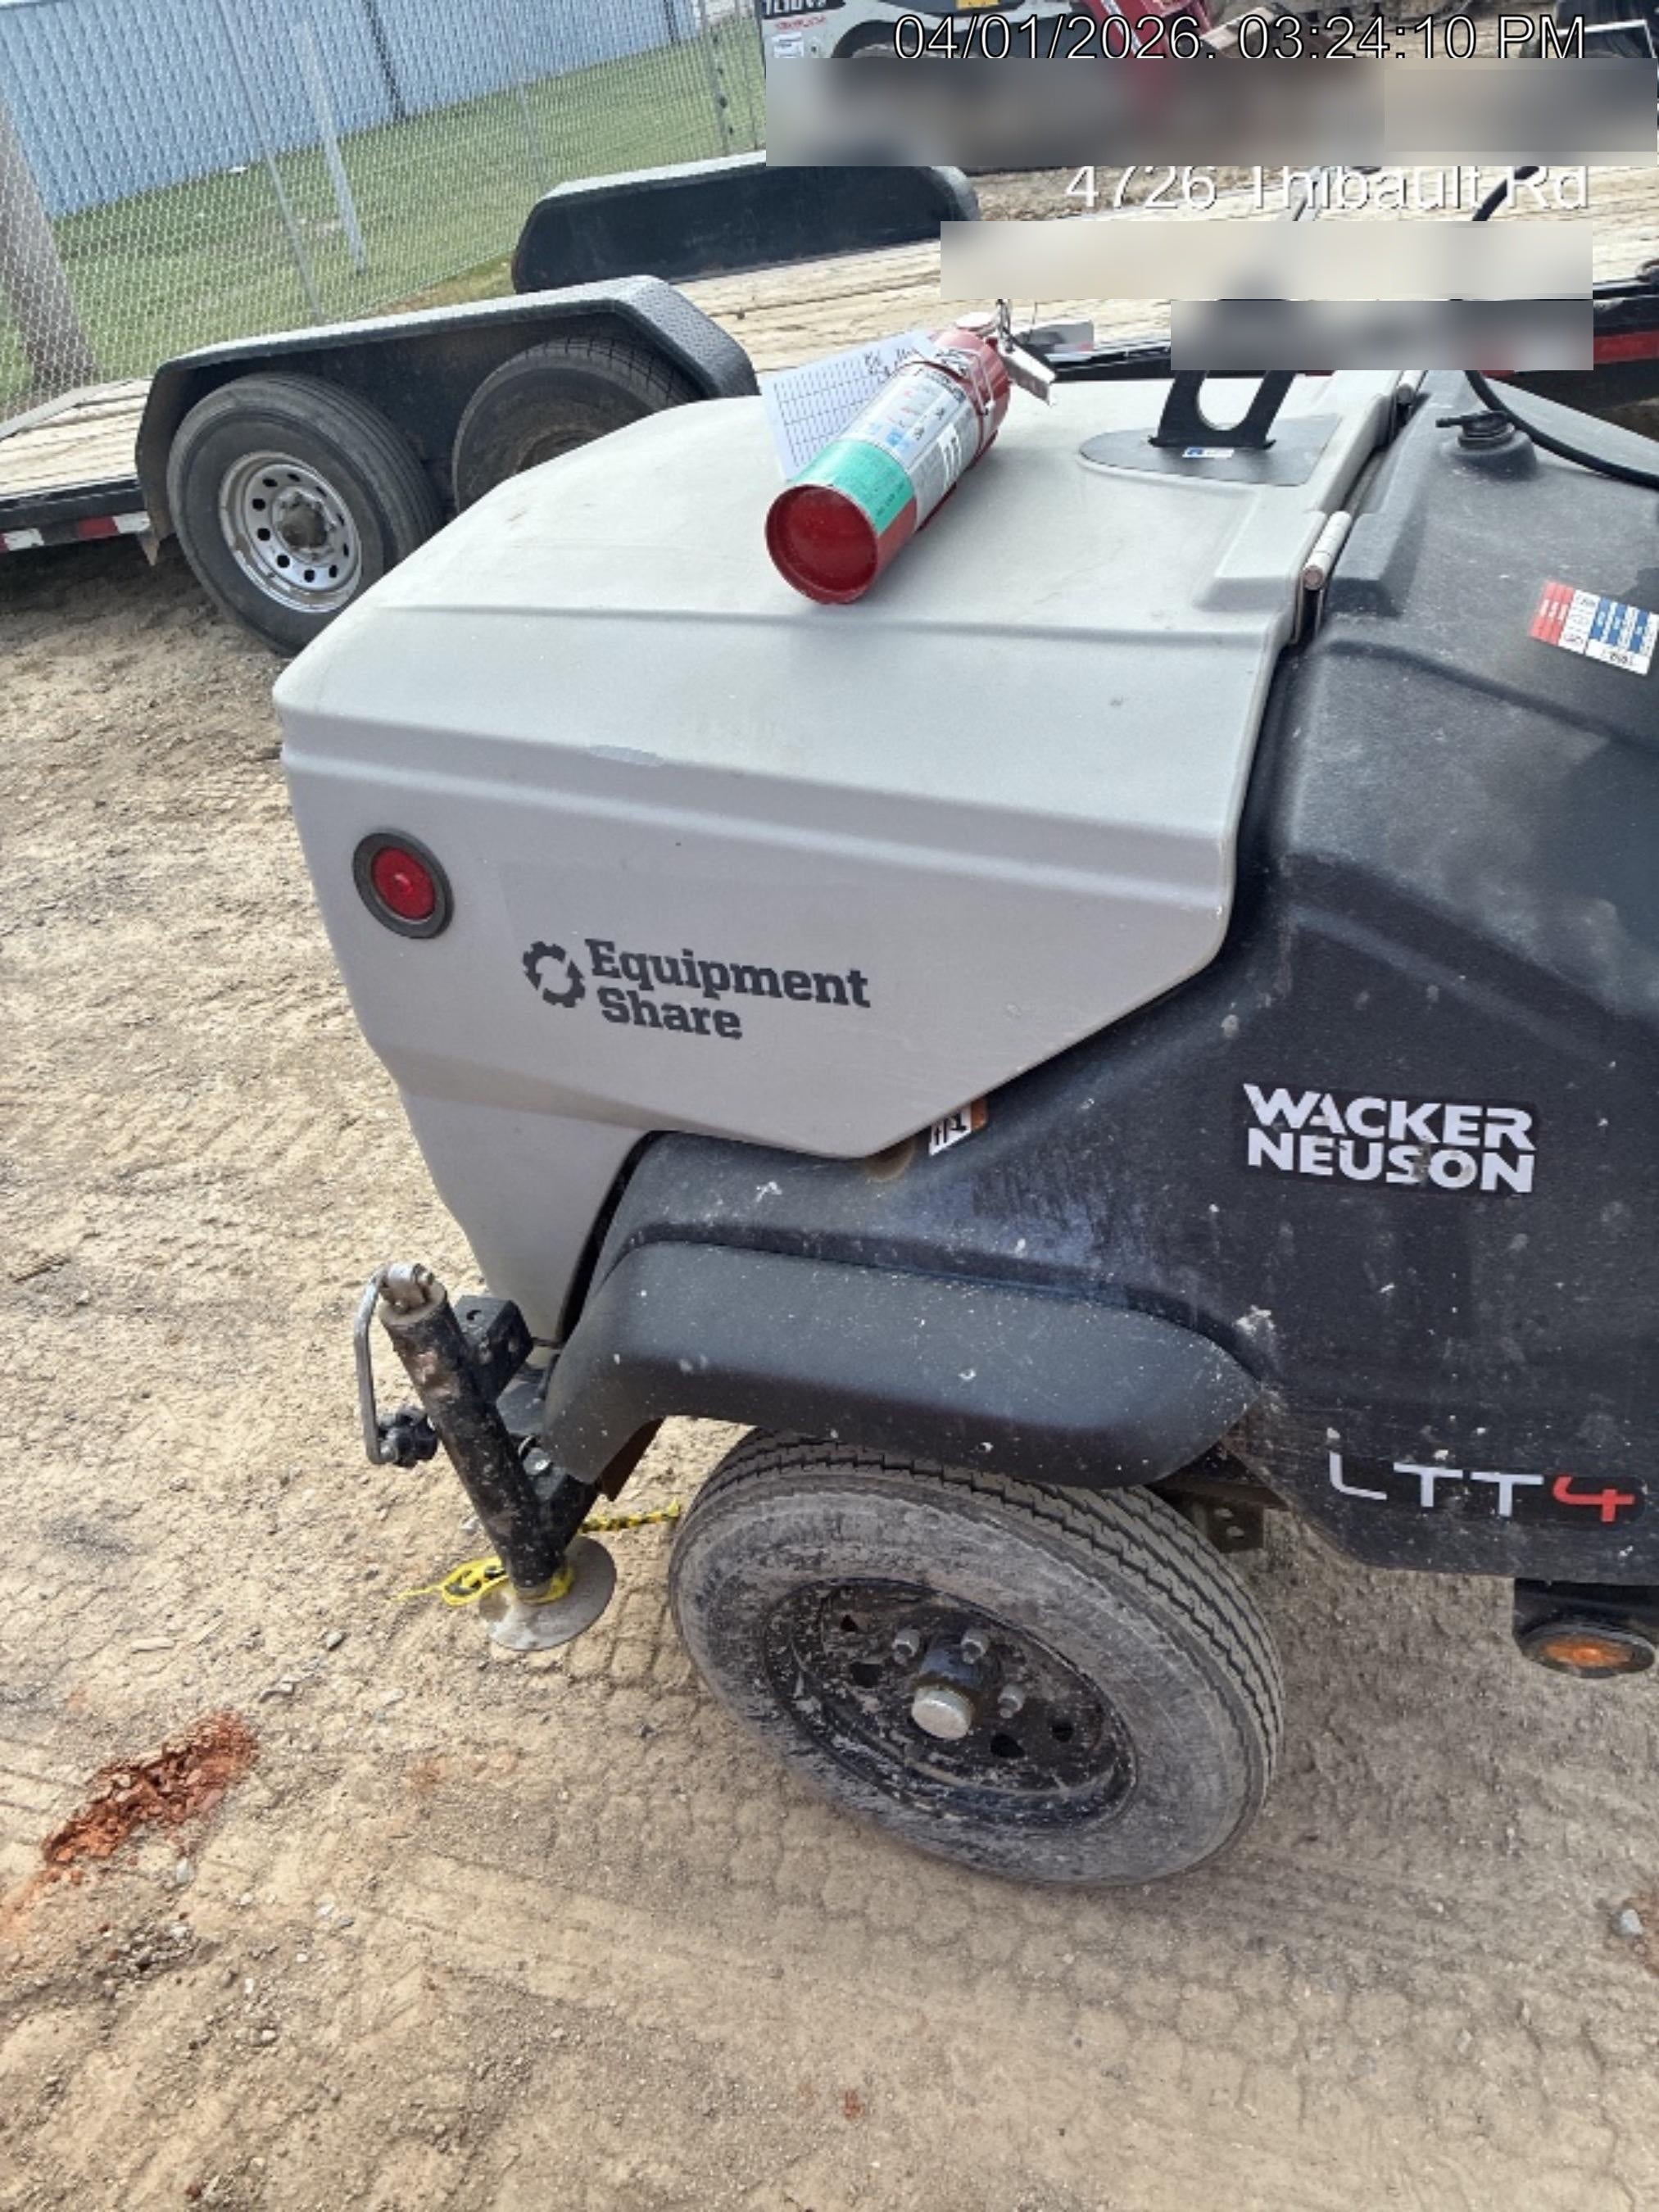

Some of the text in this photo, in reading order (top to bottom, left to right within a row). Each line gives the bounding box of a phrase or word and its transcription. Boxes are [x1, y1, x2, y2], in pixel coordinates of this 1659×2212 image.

[584, 938, 871, 1009] Equipment
[596, 986, 743, 1040] Share
[1243, 1083, 1537, 1151] WACKER
[1248, 1127, 1535, 1194] NEUSON
[1329, 1451, 1635, 1522] LTT4
